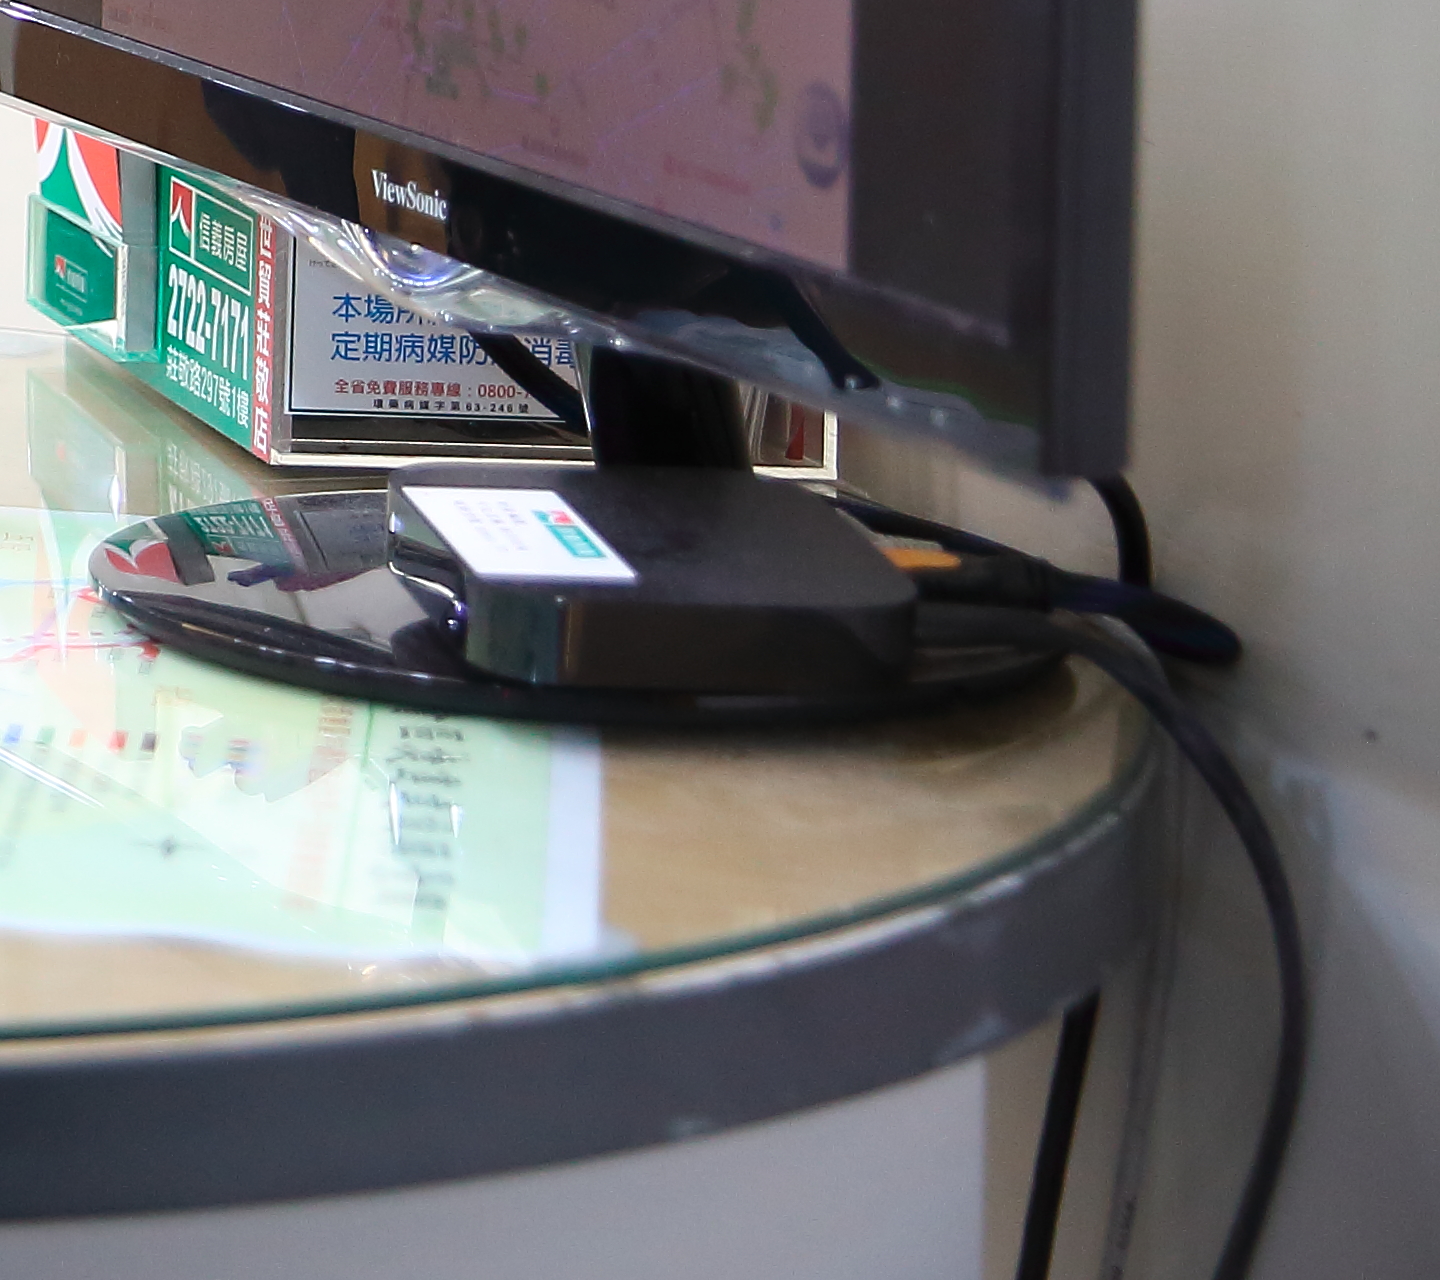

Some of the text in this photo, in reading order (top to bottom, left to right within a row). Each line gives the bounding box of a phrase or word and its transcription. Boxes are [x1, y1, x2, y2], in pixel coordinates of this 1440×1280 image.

[371, 168, 447, 221] ViewSonic
[199, 211, 247, 272] 信義房屋
[167, 263, 249, 381] 2722-7171
